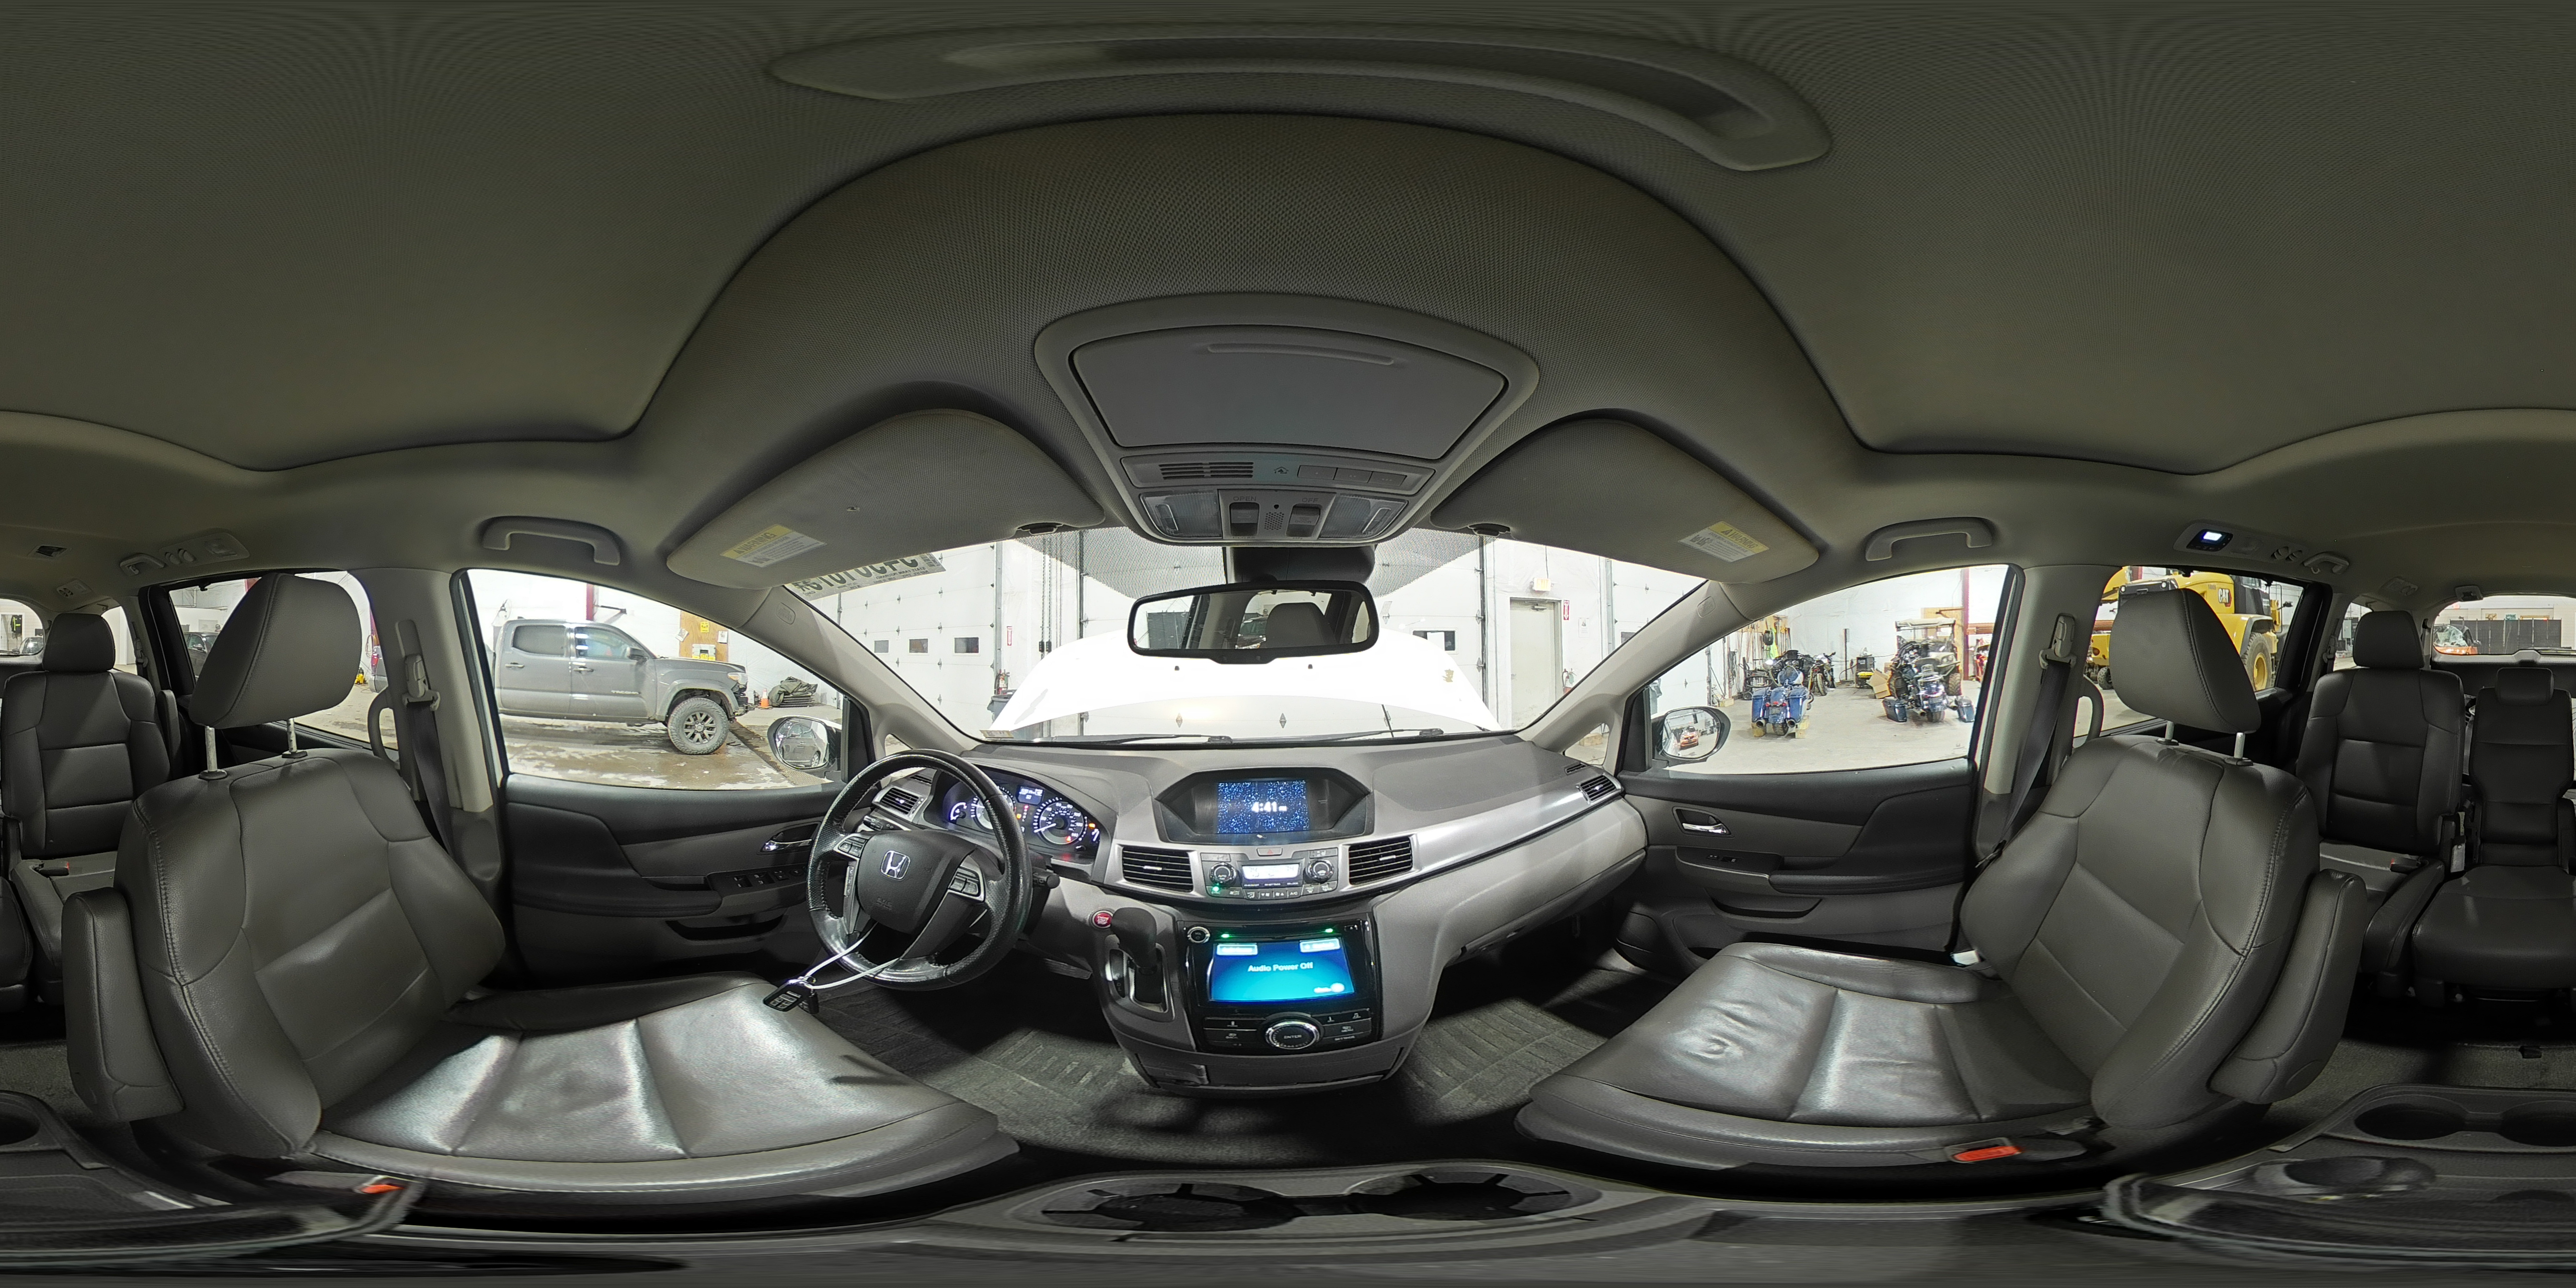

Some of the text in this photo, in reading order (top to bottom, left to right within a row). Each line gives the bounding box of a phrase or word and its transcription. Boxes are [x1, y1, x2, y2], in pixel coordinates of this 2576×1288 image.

[739, 532, 778, 552] WARNING
[1728, 531, 1759, 549] WARNING
[2219, 588, 2229, 603] CAT
[1252, 802, 1277, 813] 4:41
